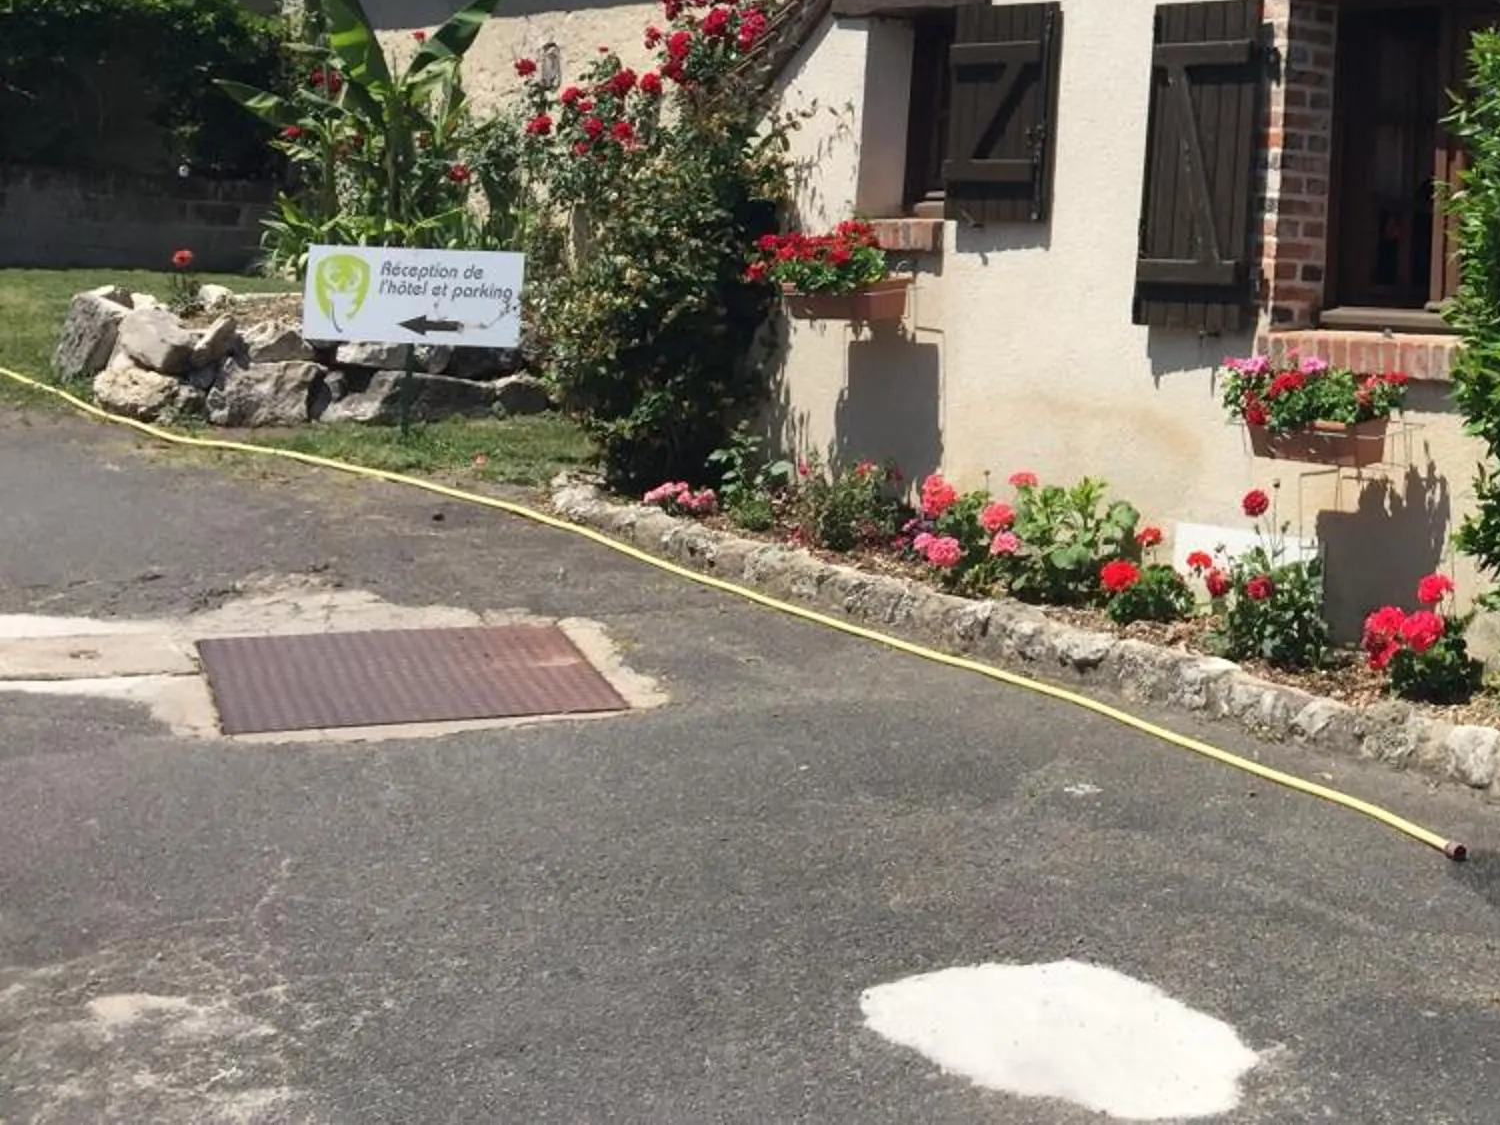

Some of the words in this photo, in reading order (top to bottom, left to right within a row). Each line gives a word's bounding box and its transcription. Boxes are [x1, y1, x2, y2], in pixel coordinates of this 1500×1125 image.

[380, 260, 458, 281] Réception
[463, 263, 484, 280] de
[379, 279, 427, 296] l'hôtel
[431, 283, 447, 296] et
[451, 283, 513, 302] parking
